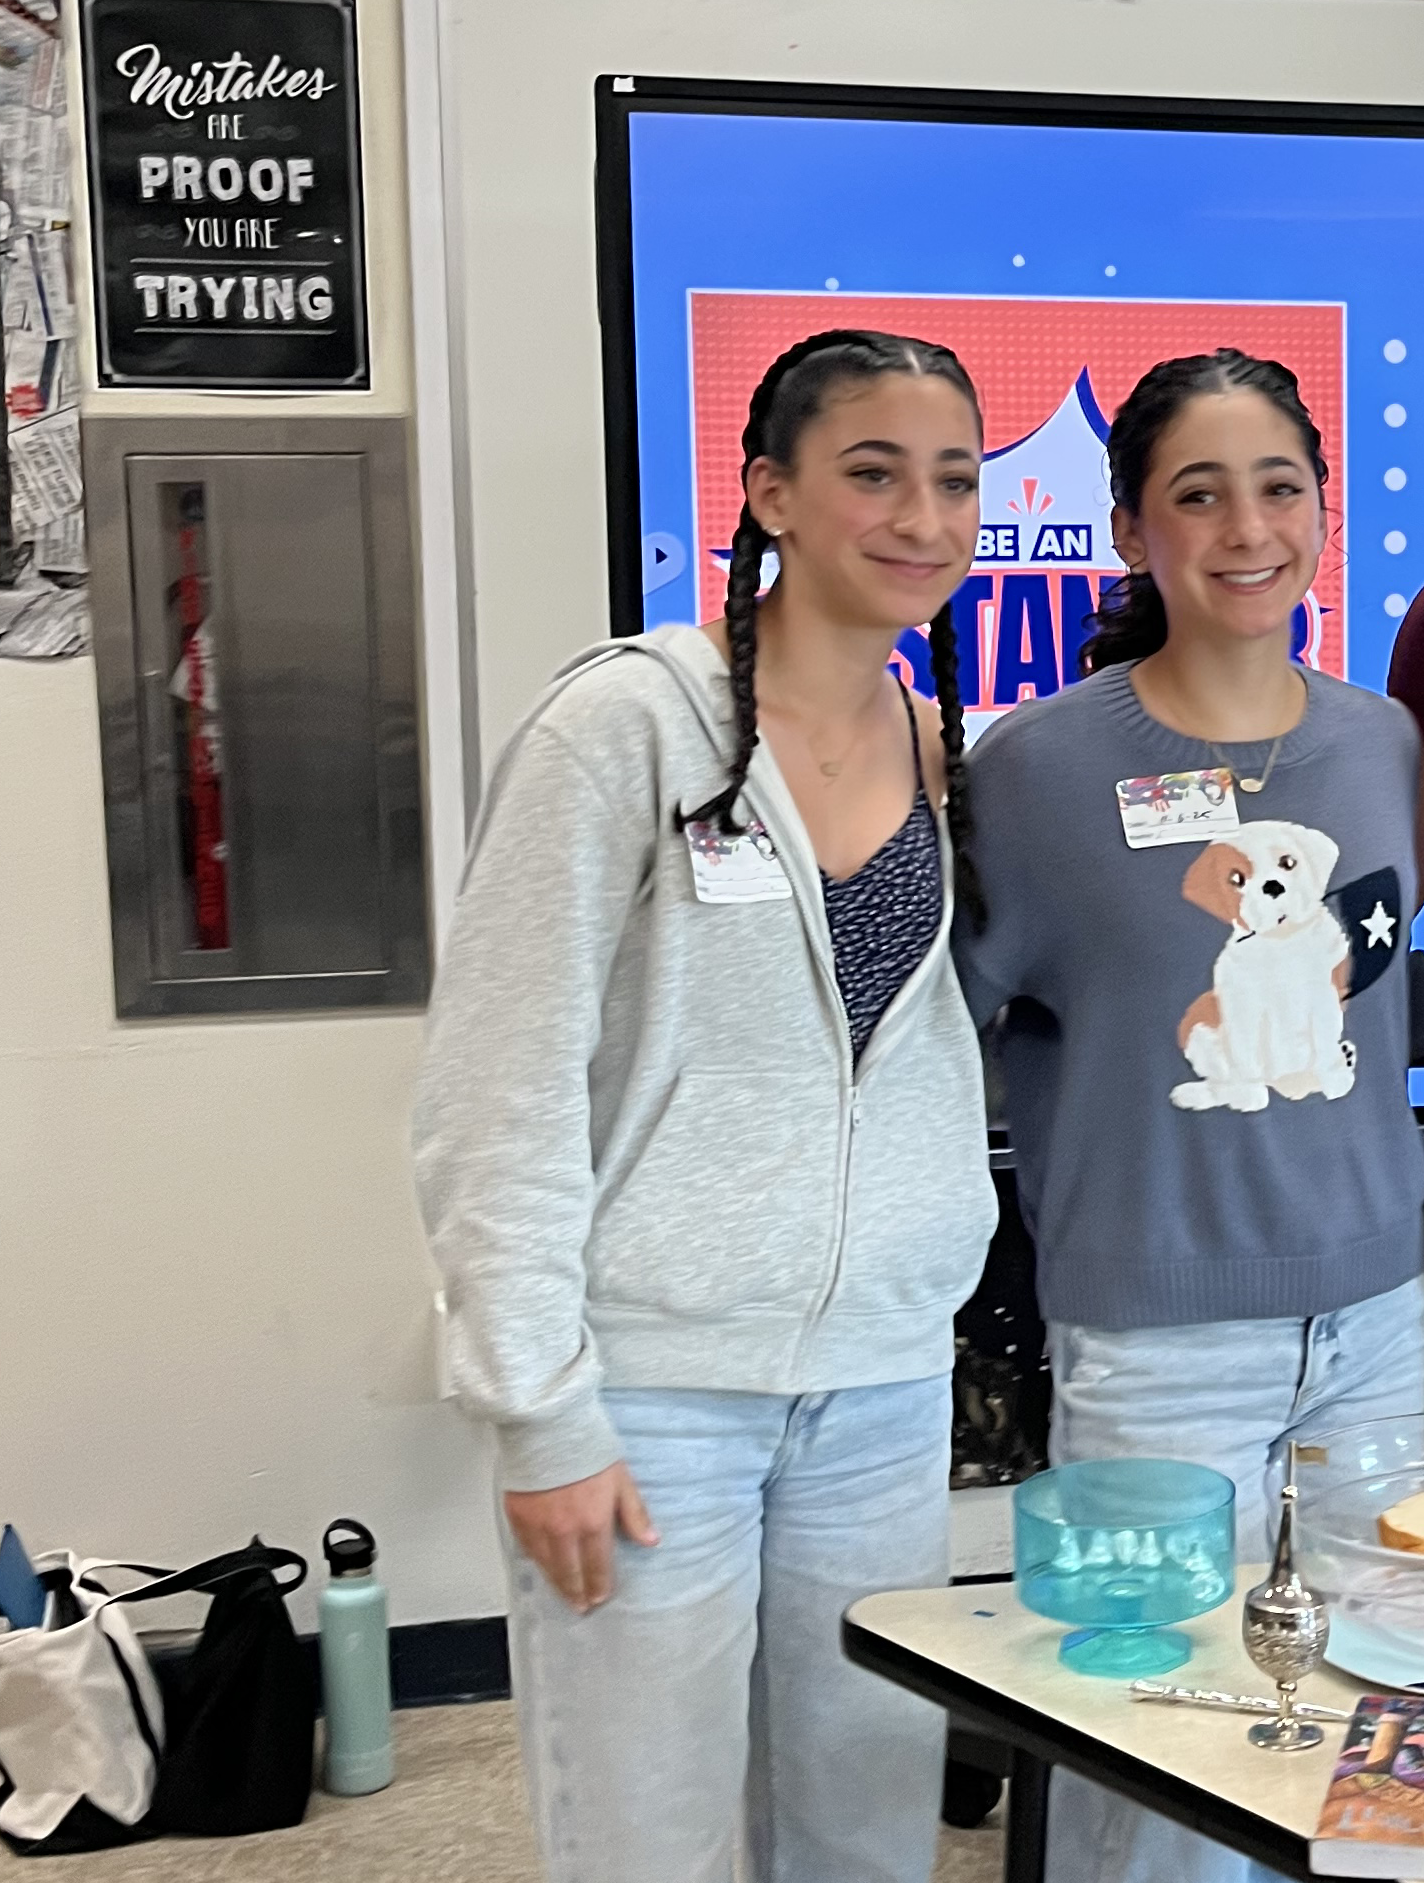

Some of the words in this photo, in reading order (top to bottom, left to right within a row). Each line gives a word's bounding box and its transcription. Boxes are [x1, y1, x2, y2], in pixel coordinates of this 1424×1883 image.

[116, 43, 338, 119] Mistakes
[207, 114, 245, 140] ARE
[139, 156, 314, 202] PROOF
[183, 217, 228, 249] YOU
[235, 218, 282, 249] ARE
[133, 275, 334, 321] TRYING
[976, 528, 1016, 558] BE
[1037, 528, 1089, 558] AN
